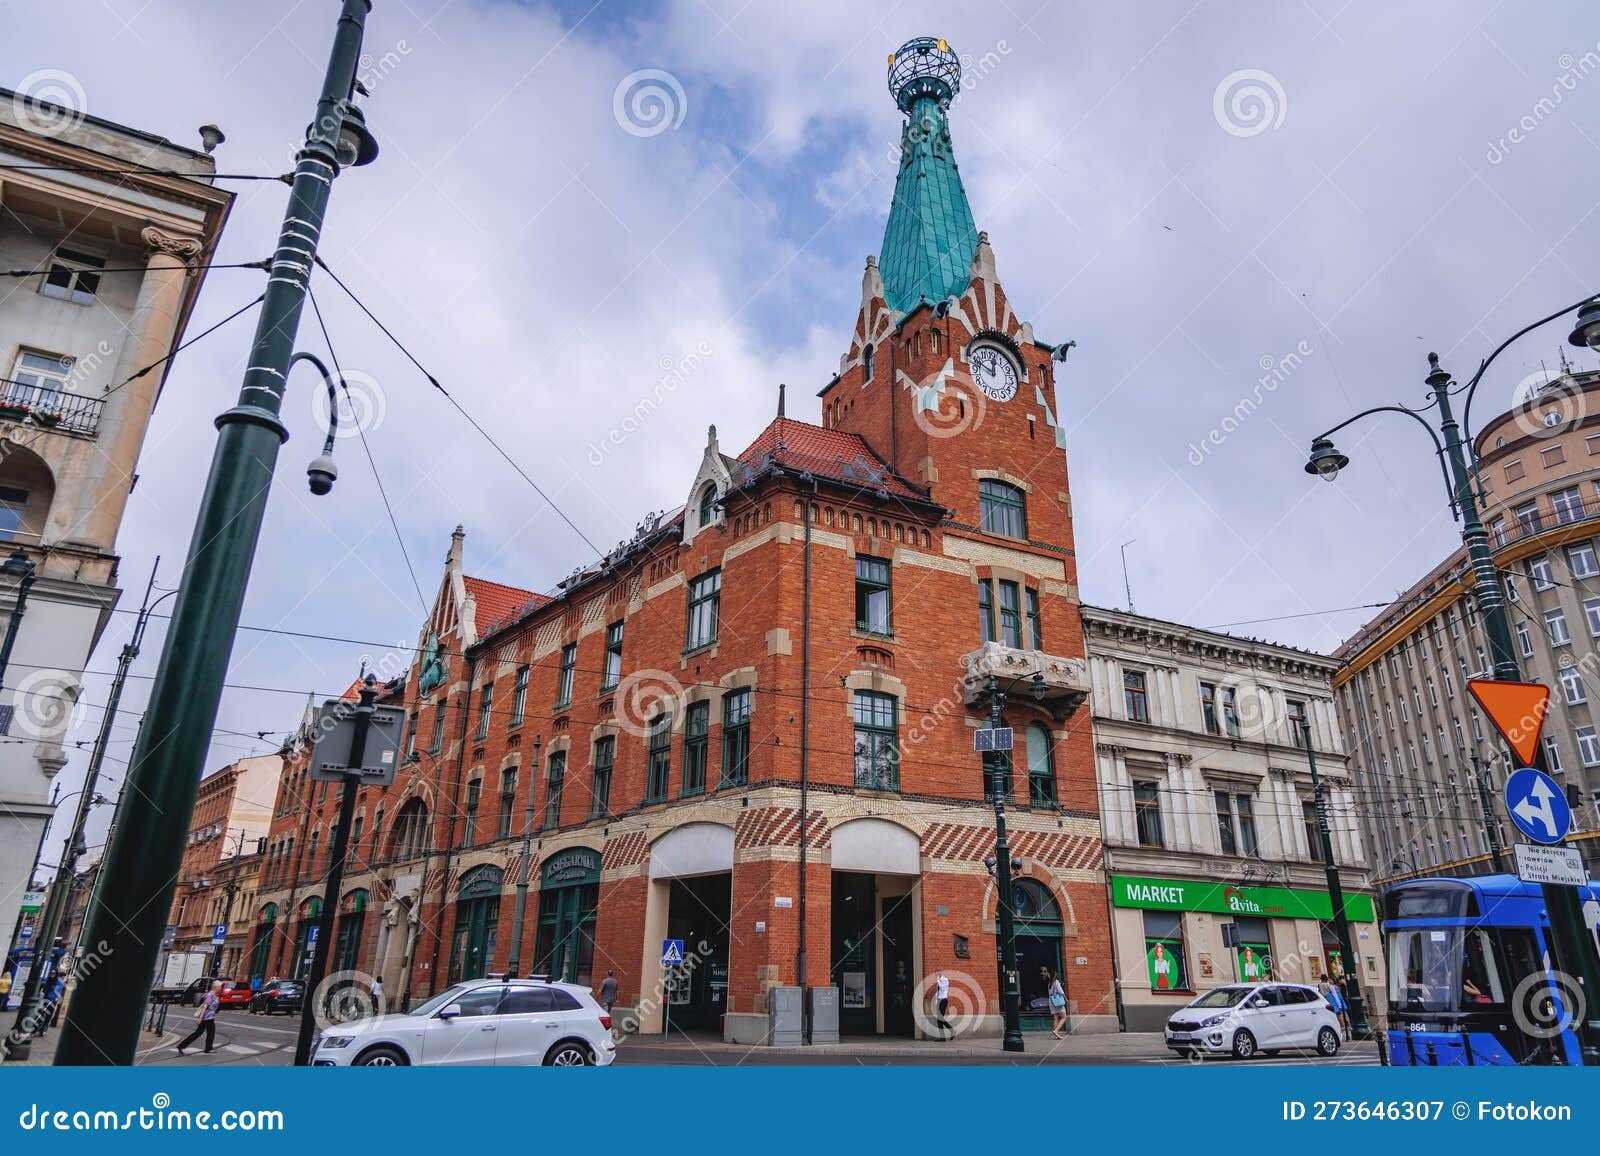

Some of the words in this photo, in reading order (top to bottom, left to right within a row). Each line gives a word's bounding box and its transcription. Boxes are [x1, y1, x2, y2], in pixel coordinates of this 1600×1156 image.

[1126, 884, 1185, 904] MARKET
[217, 925, 225, 935] P
[1410, 1023, 1426, 1032] 864
